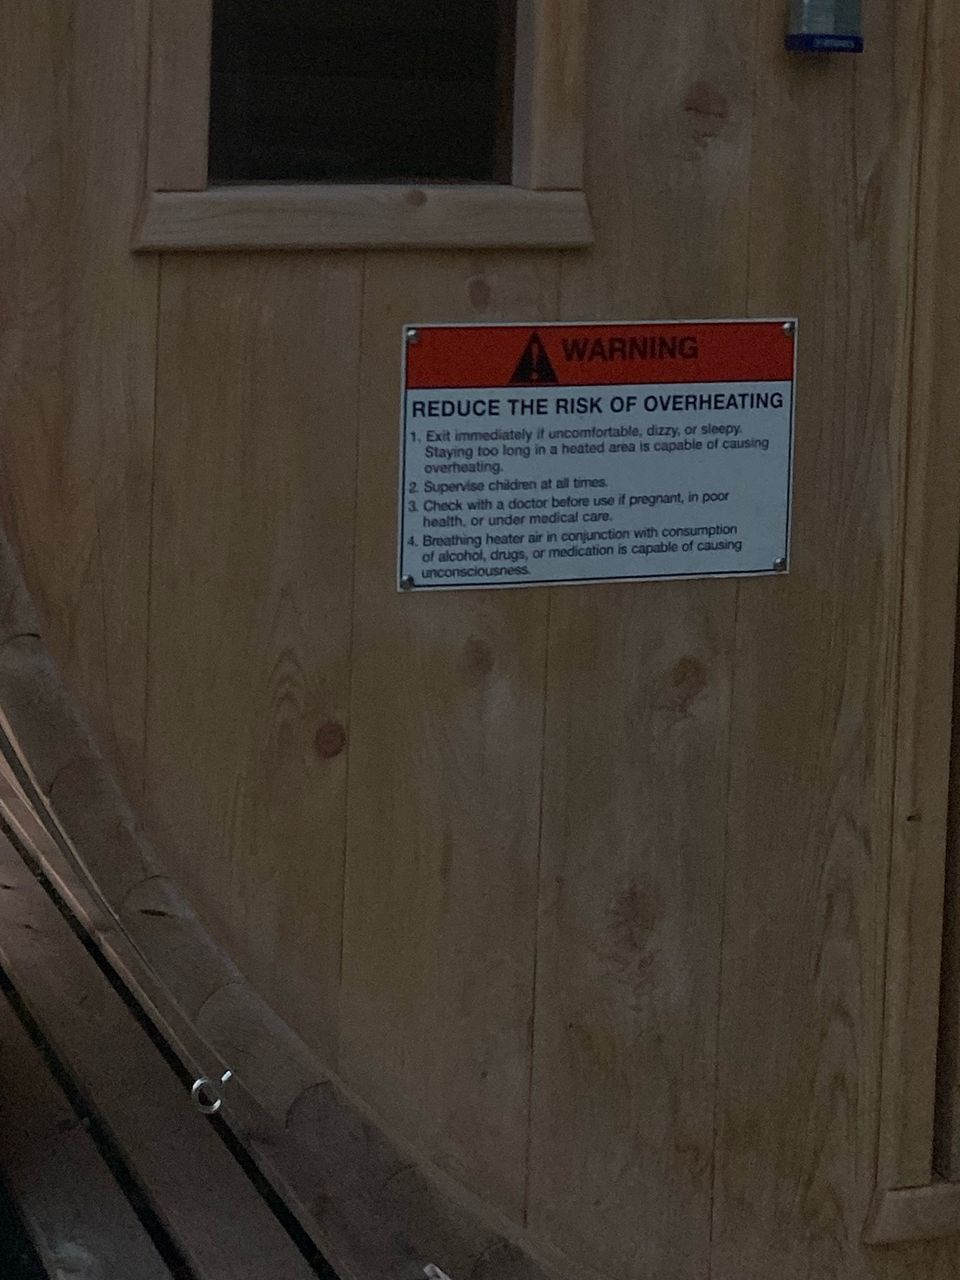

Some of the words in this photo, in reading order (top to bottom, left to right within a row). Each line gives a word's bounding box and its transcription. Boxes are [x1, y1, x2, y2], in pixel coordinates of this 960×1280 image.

[561, 336, 699, 362] WARNING
[412, 399, 500, 417] REDUCE
[507, 398, 548, 416] THE
[556, 397, 603, 415] RISK
[610, 396, 638, 413] OF
[643, 392, 784, 412] OVERHEATING
[426, 430, 451, 442] Exit
[455, 428, 533, 443] immediately
[536, 428, 545, 439] if
[548, 425, 643, 440] uncomfortable,
[647, 424, 680, 438] dizzy,
[684, 425, 697, 435] or
[701, 423, 742, 437] sleepy.
[425, 445, 473, 460] Staying
[477, 446, 499, 457] too
[503, 444, 531, 458] long
[535, 444, 546, 455] in
[550, 445, 558, 455] a
[561, 442, 605, 455] heated
[608, 443, 636, 453] area
[640, 441, 650, 452] is
[654, 439, 703, 453] capable
[706, 438, 719, 450] of
[722, 437, 770, 451] causing
[424, 460, 504, 475] overheating.
[424, 479, 485, 495] Supervise
[488, 478, 537, 490] children
[541, 478, 552, 489] at
[556, 477, 570, 489] all
[573, 477, 608, 488] times.
[423, 499, 463, 512] Check
[467, 498, 491, 510] with
[496, 501, 504, 510] a
[508, 497, 548, 510] doctor
[552, 495, 590, 508] before
[593, 496, 615, 506] use
[618, 493, 626, 505] if
[629, 492, 684, 507] pregnant,
[688, 491, 699, 503] in
[703, 491, 730, 504] poor
[423, 515, 466, 528] health,
[471, 516, 483, 526] or
[488, 513, 525, 526] under
[529, 512, 579, 525] medical
[582, 511, 613, 523] care.
[423, 533, 482, 549] Breathing
[486, 533, 525, 545] heater
[528, 532, 543, 543] air
[546, 531, 557, 543] in
[561, 527, 630, 544] conjunction
[634, 526, 658, 538] with
[662, 524, 737, 538] consumption
[422, 550, 435, 563] of
[438, 549, 486, 563] alcohol,
[490, 549, 529, 563] drugs,
[532, 548, 546, 559] or
[548, 543, 614, 559] medication
[618, 543, 628, 555] is
[631, 541, 679, 556] capable
[682, 540, 693, 552] of
[697, 539, 742, 553] causing
[422, 564, 530, 579] unconsciousness.
